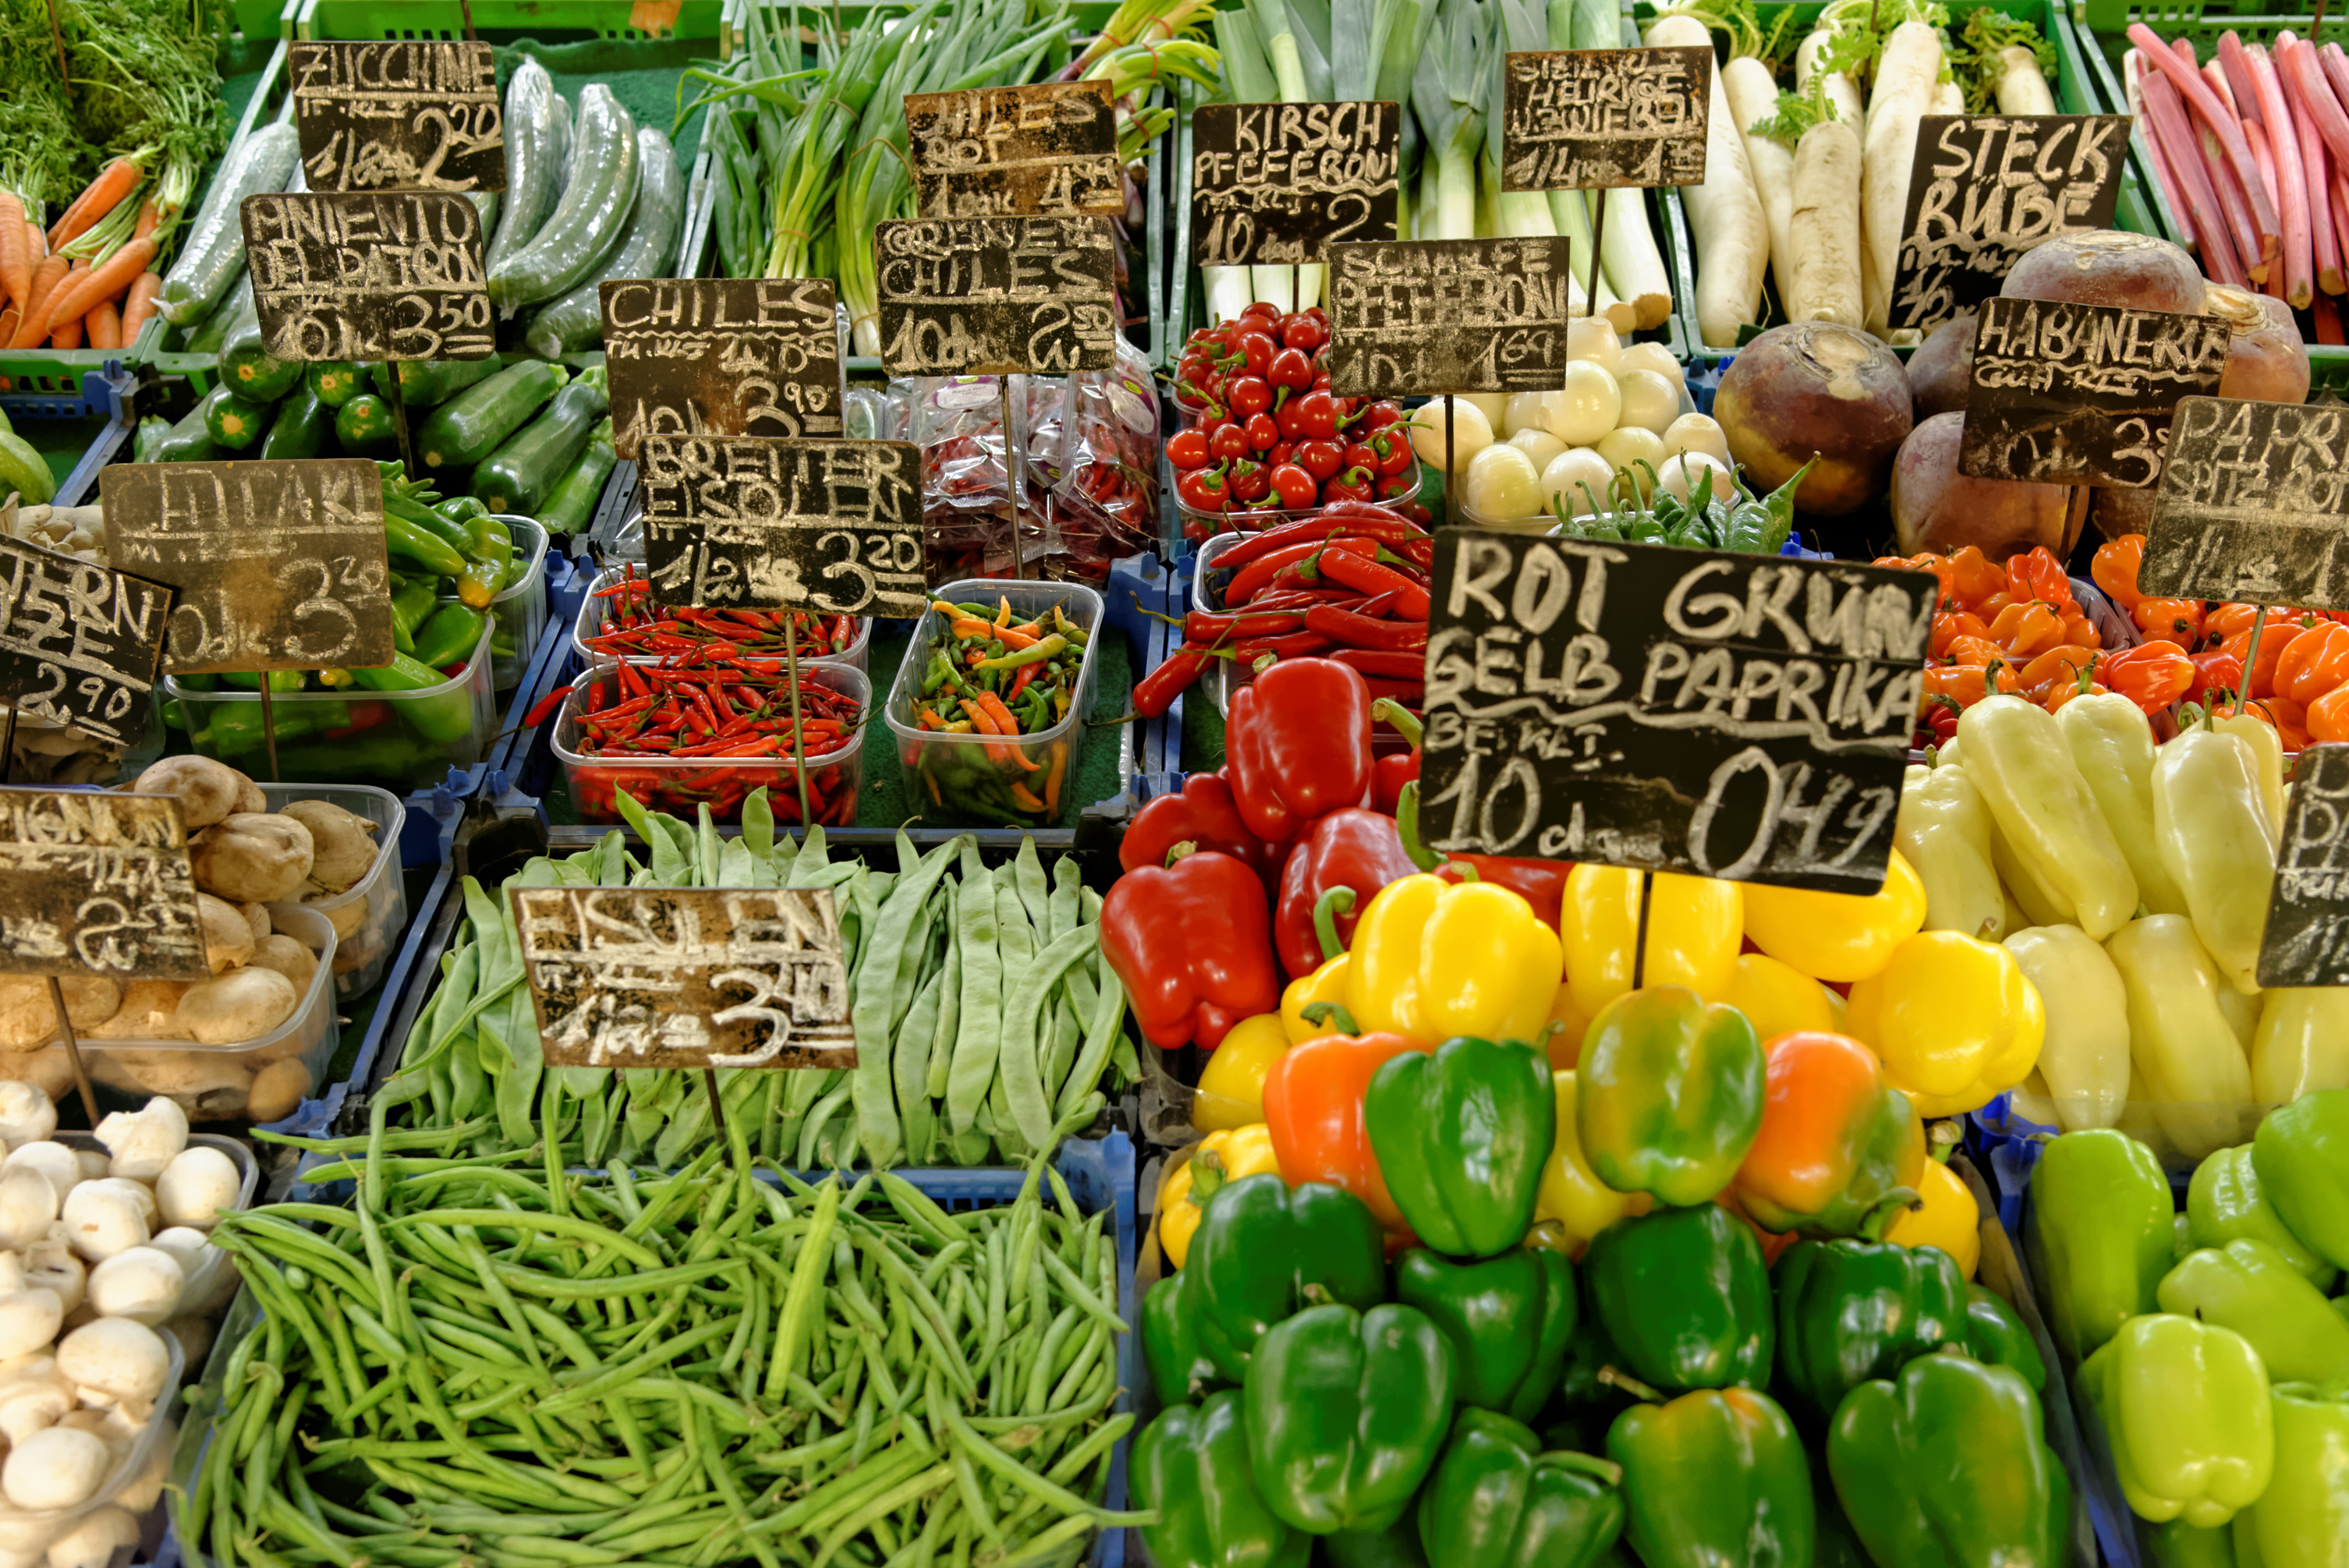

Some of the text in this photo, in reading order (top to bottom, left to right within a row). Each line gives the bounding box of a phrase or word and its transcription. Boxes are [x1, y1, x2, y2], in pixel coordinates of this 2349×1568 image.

[1235, 102, 1383, 152] KIRSCH
[1931, 117, 2119, 187] STECK
[609, 282, 835, 331] CHILES
[880, 249, 1103, 298] CHILES
[1446, 536, 1630, 635] ROT
[1423, 626, 1923, 734] GELB PAPRIKA
[1423, 751, 1541, 855] 10
